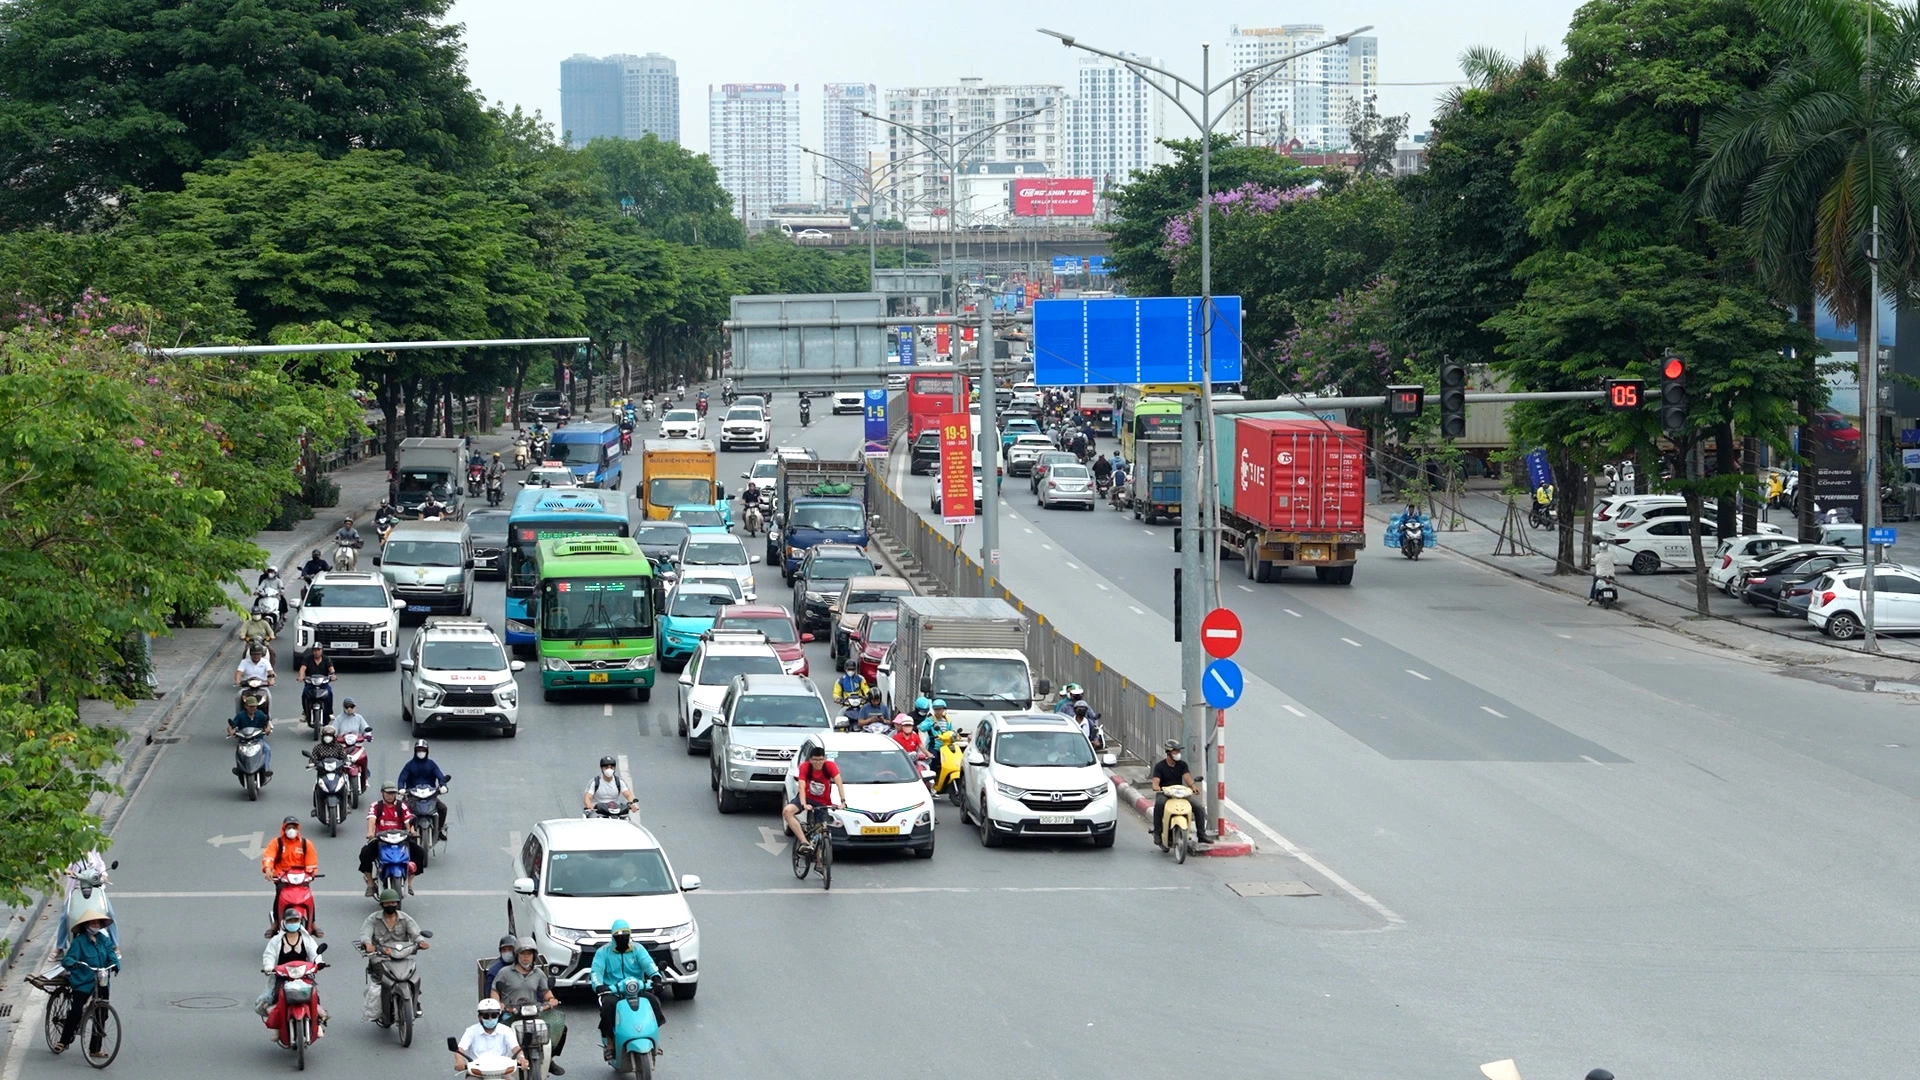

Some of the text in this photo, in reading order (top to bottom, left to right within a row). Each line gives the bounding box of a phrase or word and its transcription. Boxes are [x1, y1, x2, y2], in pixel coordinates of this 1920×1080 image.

[845, 86, 864, 96] MB
[1019, 188, 1047, 197] CHENG
[1613, 386, 1637, 406] 05
[867, 405, 884, 418] 1-5
